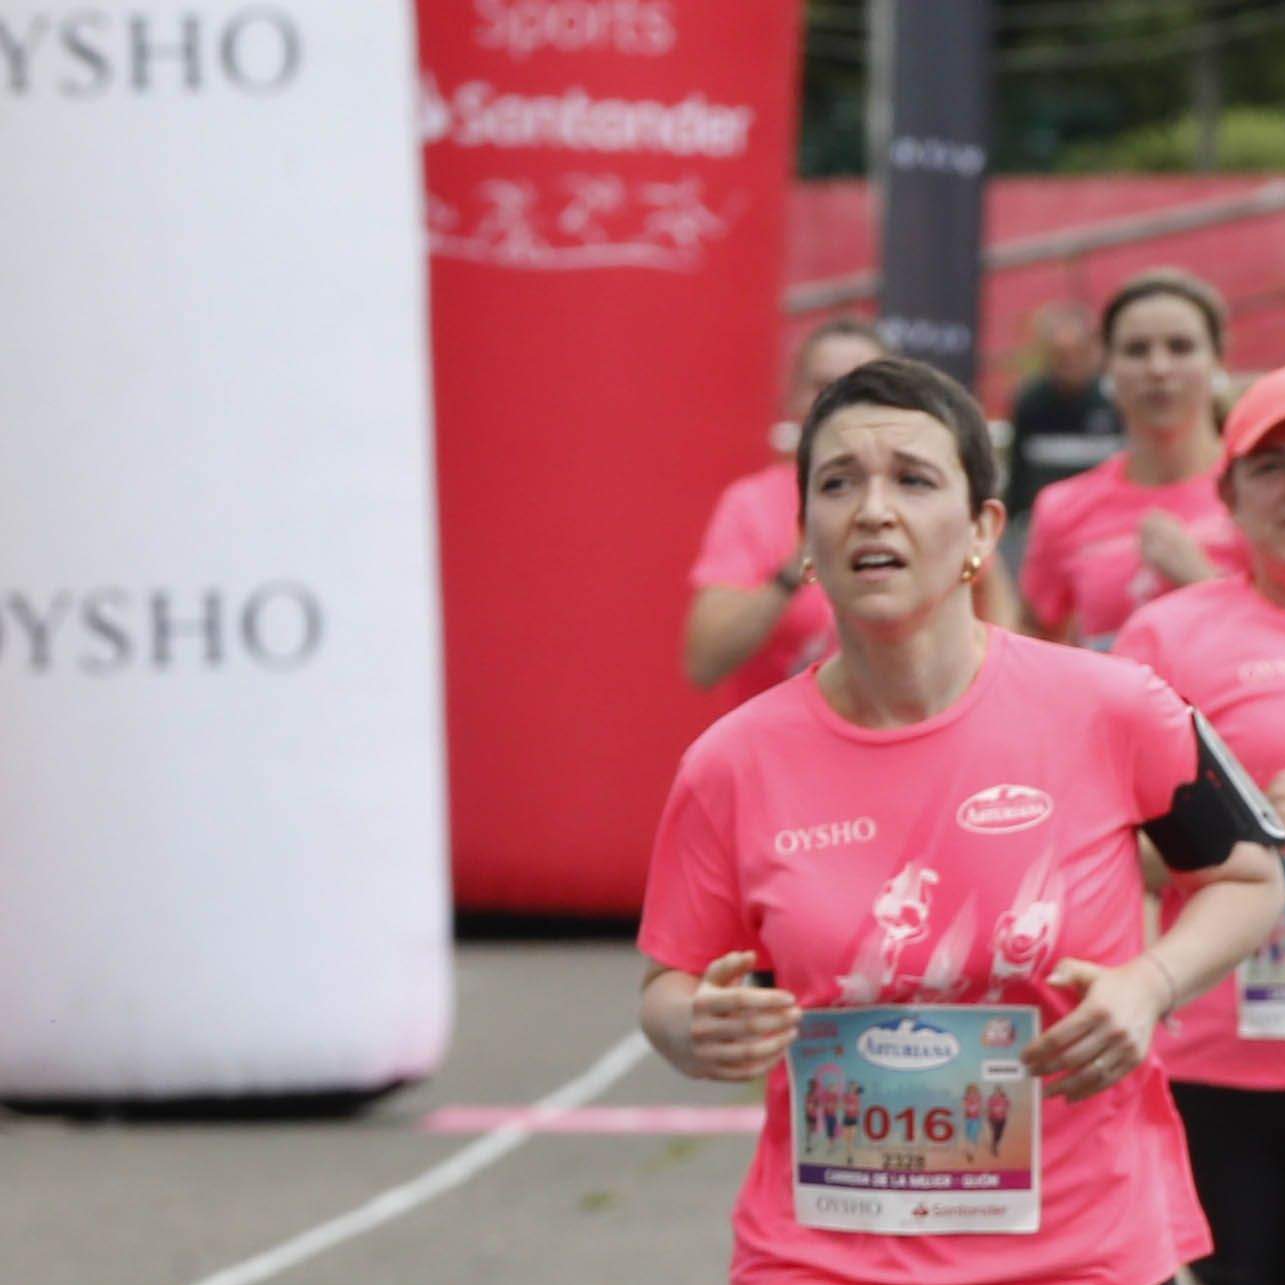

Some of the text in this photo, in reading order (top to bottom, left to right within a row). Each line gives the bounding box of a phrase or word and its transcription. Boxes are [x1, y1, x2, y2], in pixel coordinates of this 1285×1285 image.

[453, 80, 755, 157] Santander
[0, 580, 323, 678] YSHO
[775, 815, 876, 856] OYSHO
[863, 1105, 955, 1142] 016
